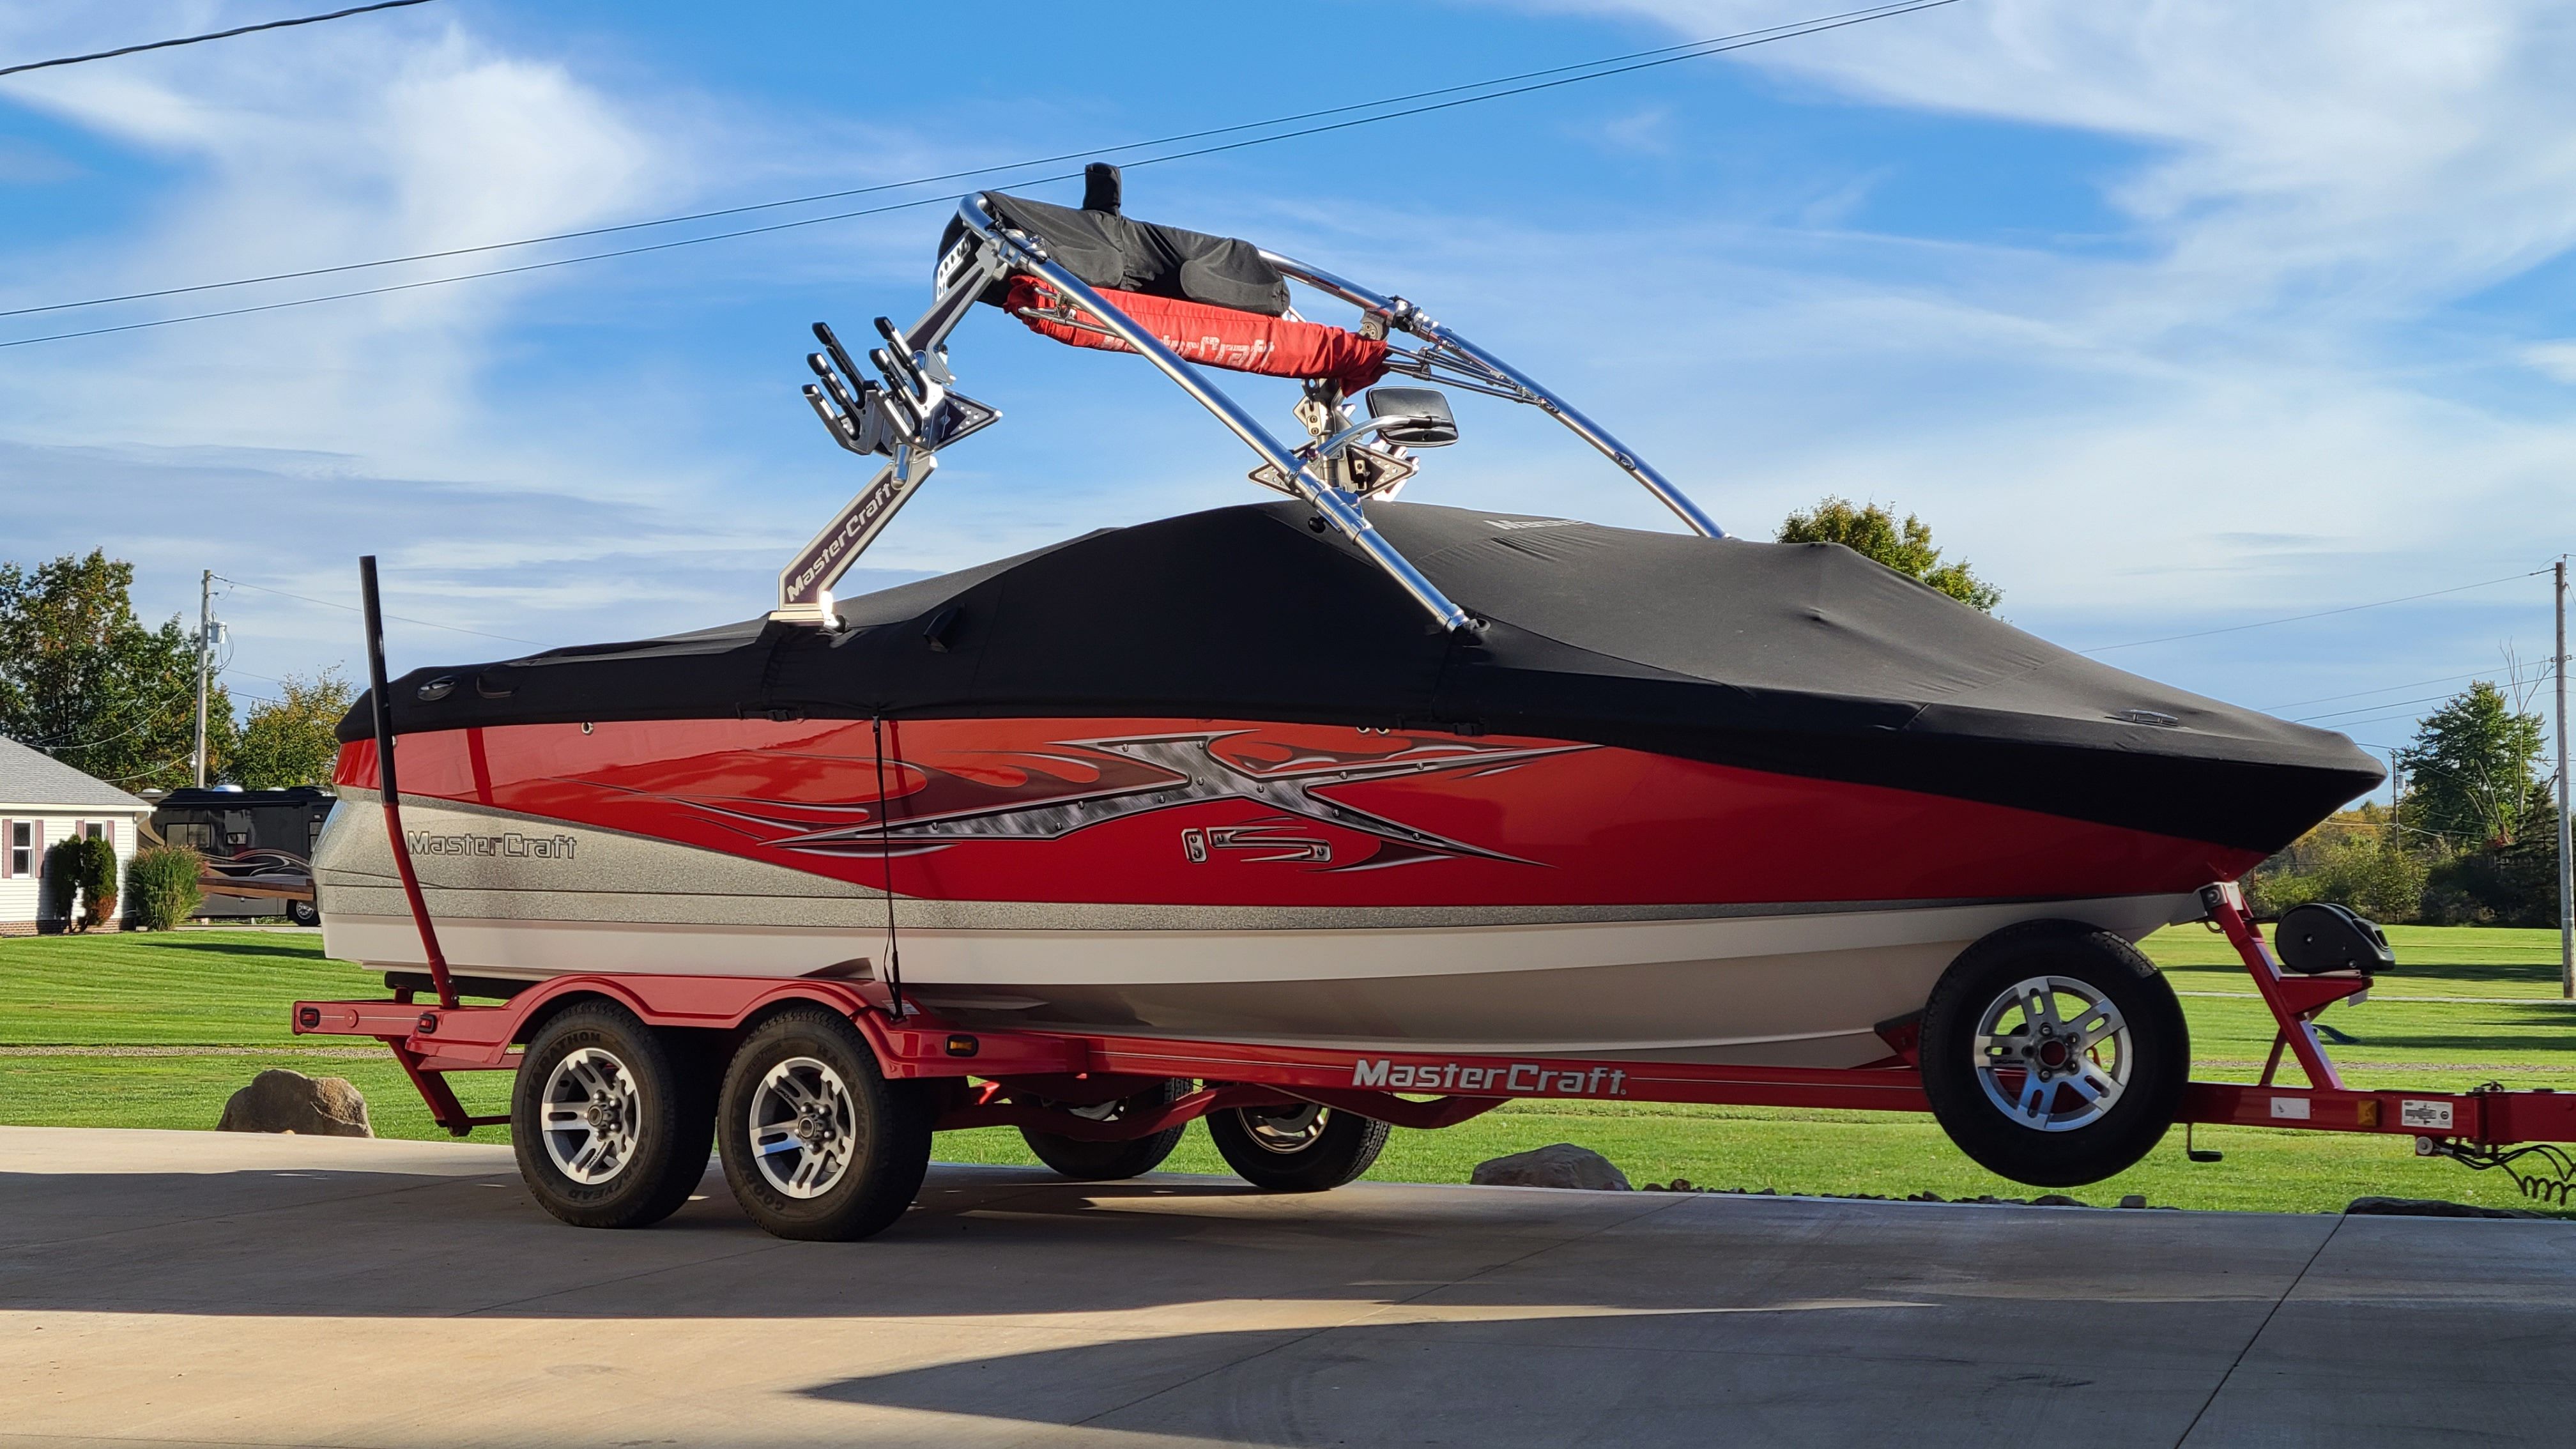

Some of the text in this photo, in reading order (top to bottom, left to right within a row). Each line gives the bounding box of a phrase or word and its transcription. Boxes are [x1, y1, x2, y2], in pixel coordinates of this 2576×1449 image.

[786, 482, 892, 602] MasterCraft
[407, 831, 577, 859] MasterCraft
[528, 1031, 601, 1101] MARATHON
[1353, 1059, 1626, 1094] MasterCraft
